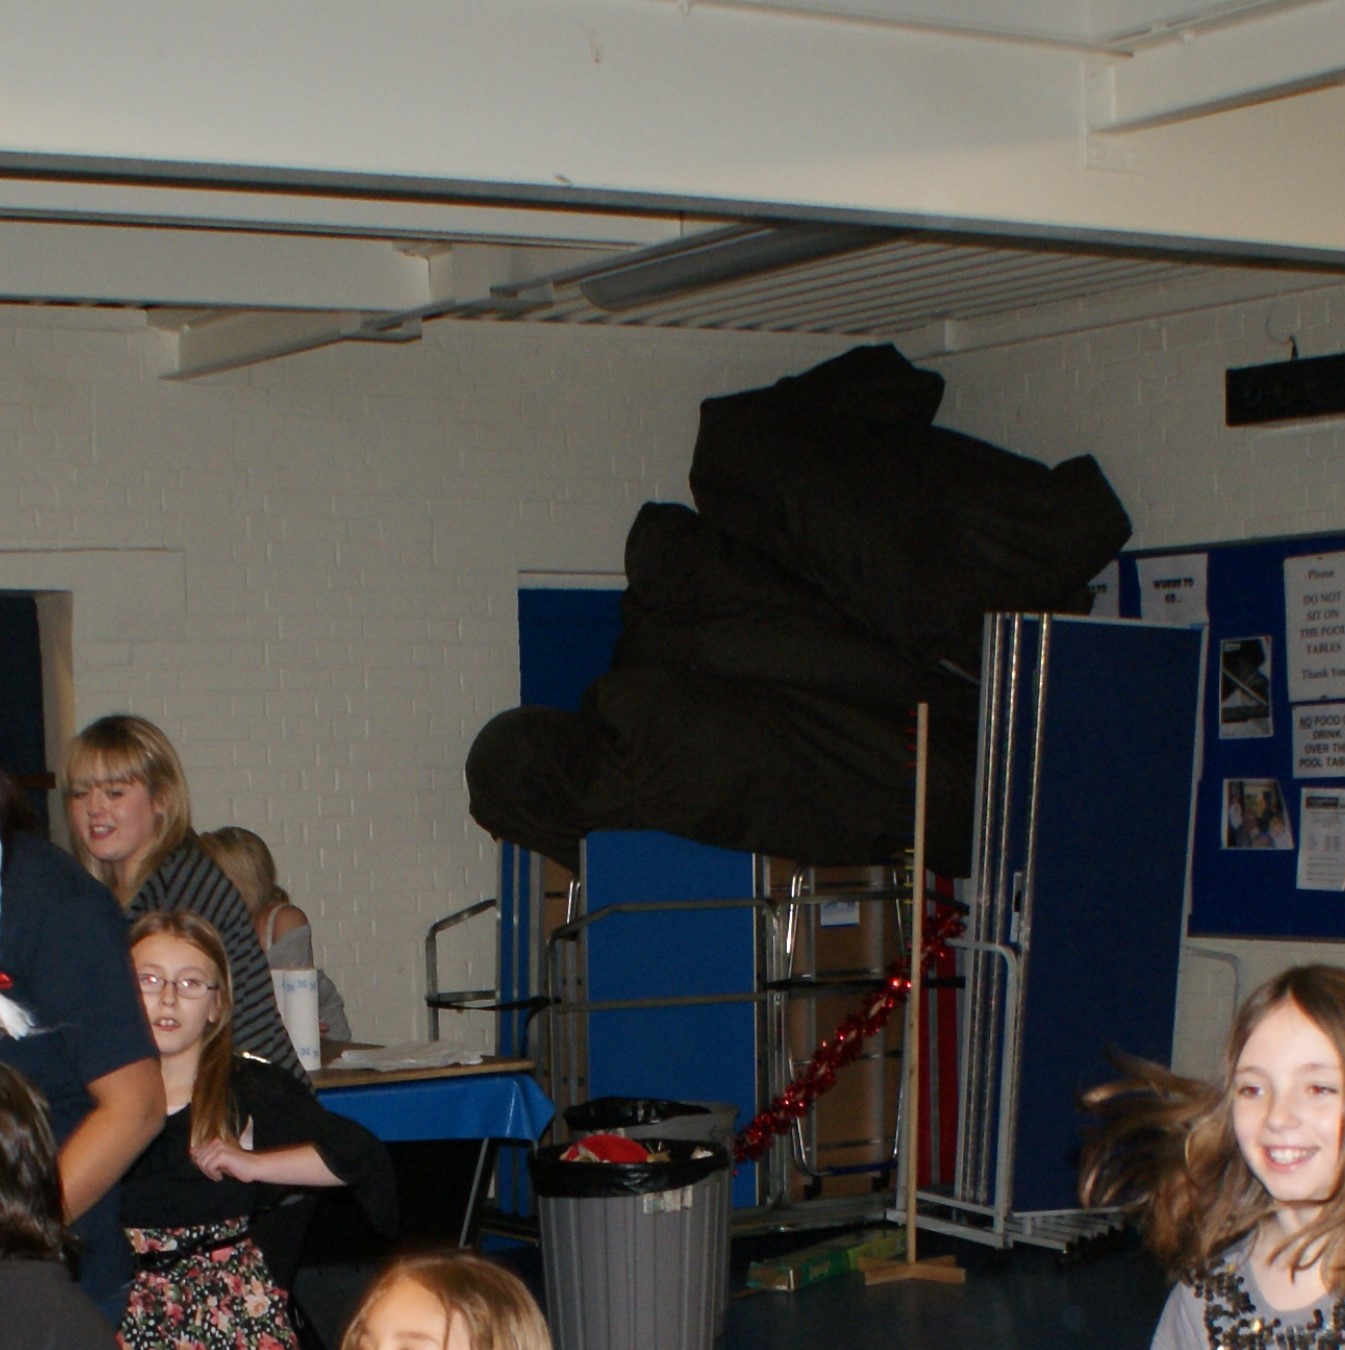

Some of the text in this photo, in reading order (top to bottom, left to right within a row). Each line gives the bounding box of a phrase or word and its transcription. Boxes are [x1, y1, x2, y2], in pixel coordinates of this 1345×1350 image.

[1302, 591, 1342, 605] DO NOT
[1306, 608, 1340, 621] SIT ON
[1300, 624, 1345, 638] THE POOL
[1306, 642, 1343, 654] TABLES
[1299, 716, 1313, 729] NO
[1314, 713, 1341, 726] FOOD
[1304, 743, 1329, 754] OVER
[1299, 757, 1323, 768] POOL
